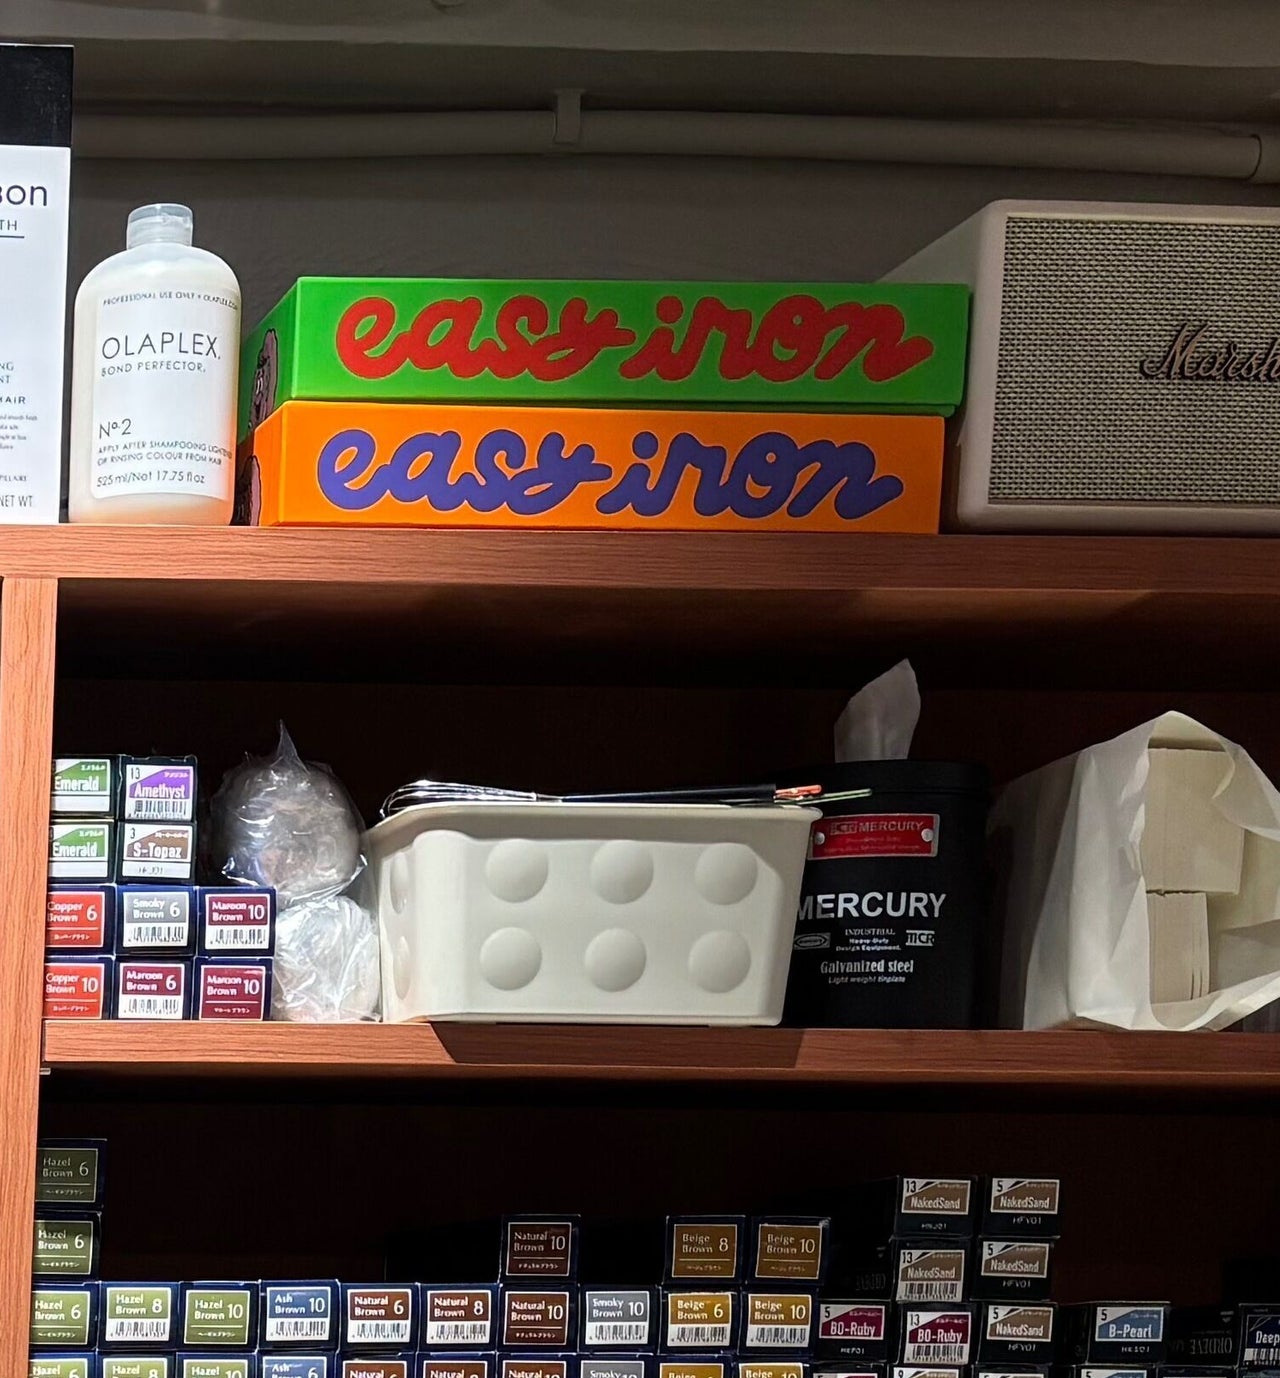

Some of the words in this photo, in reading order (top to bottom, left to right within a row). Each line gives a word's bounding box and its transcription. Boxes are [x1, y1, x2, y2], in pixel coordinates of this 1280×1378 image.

[334, 296, 636, 380] easy
[621, 293, 935, 384] iron
[101, 363, 132, 377] BOND
[316, 428, 612, 513] easy
[599, 430, 905, 519] iron
[130, 767, 140, 779] 13
[55, 776, 99, 792] Emerald
[134, 784, 186, 800] Amethyst
[130, 827, 136, 839] 3
[52, 843, 97, 858] Emerald
[133, 845, 182, 860] S-Topaz
[47, 902, 83, 912] Copper
[133, 899, 164, 910] Smoky
[169, 902, 180, 917] 6
[212, 902, 247, 911] Maroon
[799, 892, 947, 920] MERCURY
[86, 905, 97, 920] 6
[133, 909, 164, 919] Brown
[212, 912, 243, 921] Brown
[248, 905, 265, 920] 10
[888, 960, 914, 972] steel
[46, 974, 79, 984] Copper
[127, 971, 163, 980] Maroon
[82, 977, 99, 993] 10
[126, 981, 157, 991] Brown
[166, 974, 176, 990] 6
[46, 984, 76, 994] Brown
[43, 1157, 71, 1167] Hazel
[42, 1167, 73, 1177] Brown
[79, 1161, 89, 1176] 6
[911, 1197, 961, 1209] NakedSand
[514, 1231, 548, 1241] Natural
[682, 1233, 710, 1243] Beige
[514, 1242, 544, 1252] Brown
[551, 1236, 566, 1250] 10
[682, 1244, 713, 1253] Brown
[719, 1238, 729, 1252] 8
[991, 1260, 1039, 1272] NakedSand
[116, 1294, 144, 1304] Hazel
[195, 1299, 222, 1309] Hazel
[275, 1294, 293, 1303] Ash
[355, 1296, 388, 1305] Natural
[592, 1297, 624, 1308] Smoky
[116, 1305, 147, 1315] Brown
[152, 1298, 162, 1314] 8
[275, 1305, 305, 1314] Brown
[310, 1298, 325, 1312] 10
[393, 1300, 404, 1314] 6
[628, 1302, 644, 1316] 10
[195, 1310, 225, 1320] Brown
[228, 1304, 243, 1319] 10
[355, 1307, 385, 1316] Brown
[593, 1309, 623, 1318] Brown
[824, 1306, 830, 1318] 5
[1109, 1325, 1152, 1338] B-Pearl
[430, 1370, 464, 1378] Natural
[745, 1370, 773, 1378] Beige
